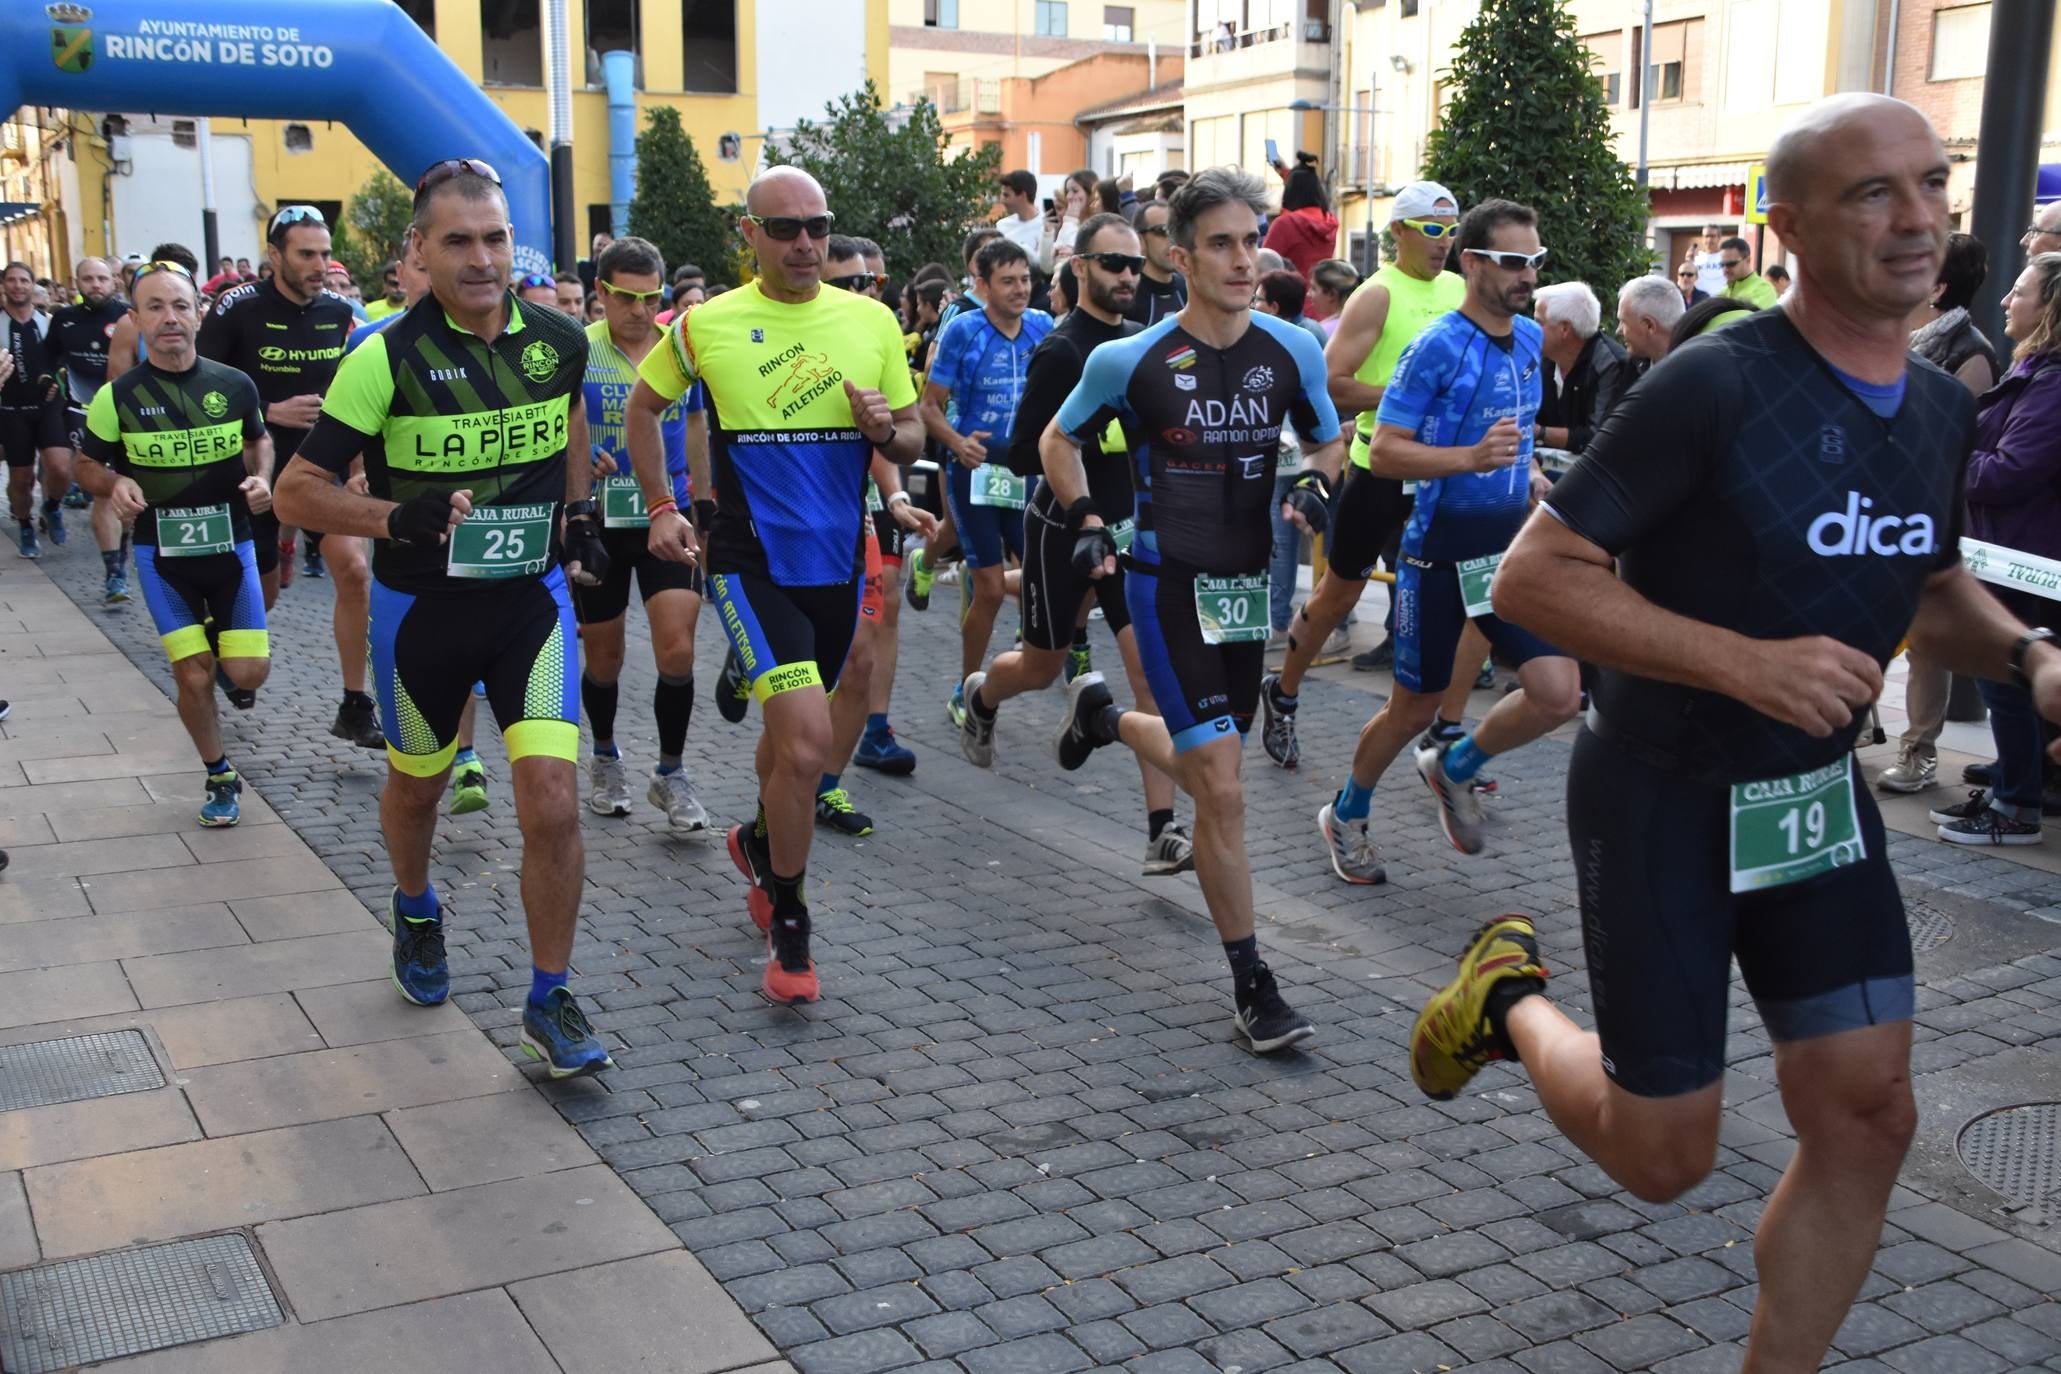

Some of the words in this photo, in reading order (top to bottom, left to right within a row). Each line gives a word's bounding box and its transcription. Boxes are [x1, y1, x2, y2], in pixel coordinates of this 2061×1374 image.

[138, 19, 273, 41] AYUNTAMIENTO
[277, 27, 300, 42] DE
[105, 35, 213, 63] RINCÓN
[219, 41, 256, 65] DE
[262, 43, 334, 68] SOTO
[758, 342, 806, 378] RINCON
[429, 367, 467, 382] GOBIK
[782, 371, 842, 420] ATLETISMO
[452, 411, 523, 430] TRAVESIA
[525, 405, 548, 420] BTT
[1184, 393, 1269, 427] ADÁN
[133, 443, 164, 458] LA
[173, 433, 238, 457] PERA
[153, 429, 206, 442] TRAVESIA
[207, 426, 224, 437] BTT
[416, 433, 465, 457] LA
[480, 414, 564, 454] PERA
[737, 431, 775, 444] RINCÓN
[776, 433, 790, 443] DE
[792, 432, 819, 443] SOTO
[825, 432, 838, 441] LA
[415, 456, 493, 467] RINCÓN
[503, 452, 522, 461] DE
[611, 478, 636, 488] CAJA
[988, 476, 1011, 497] 28
[502, 505, 546, 520] RURAL
[628, 492, 649, 515] 1
[179, 521, 209, 544] 21
[1807, 490, 1935, 557] dica
[482, 528, 526, 560] 25
[1406, 556, 1433, 569] 2XU
[1463, 559, 1488, 572] CAJA
[2007, 562, 2061, 590] RURAL
[1217, 596, 1249, 626] 30
[769, 667, 810, 685] RINCÓN
[772, 683, 785, 693] DE
[788, 676, 813, 689] SOTO
[1778, 800, 1825, 855] 19
